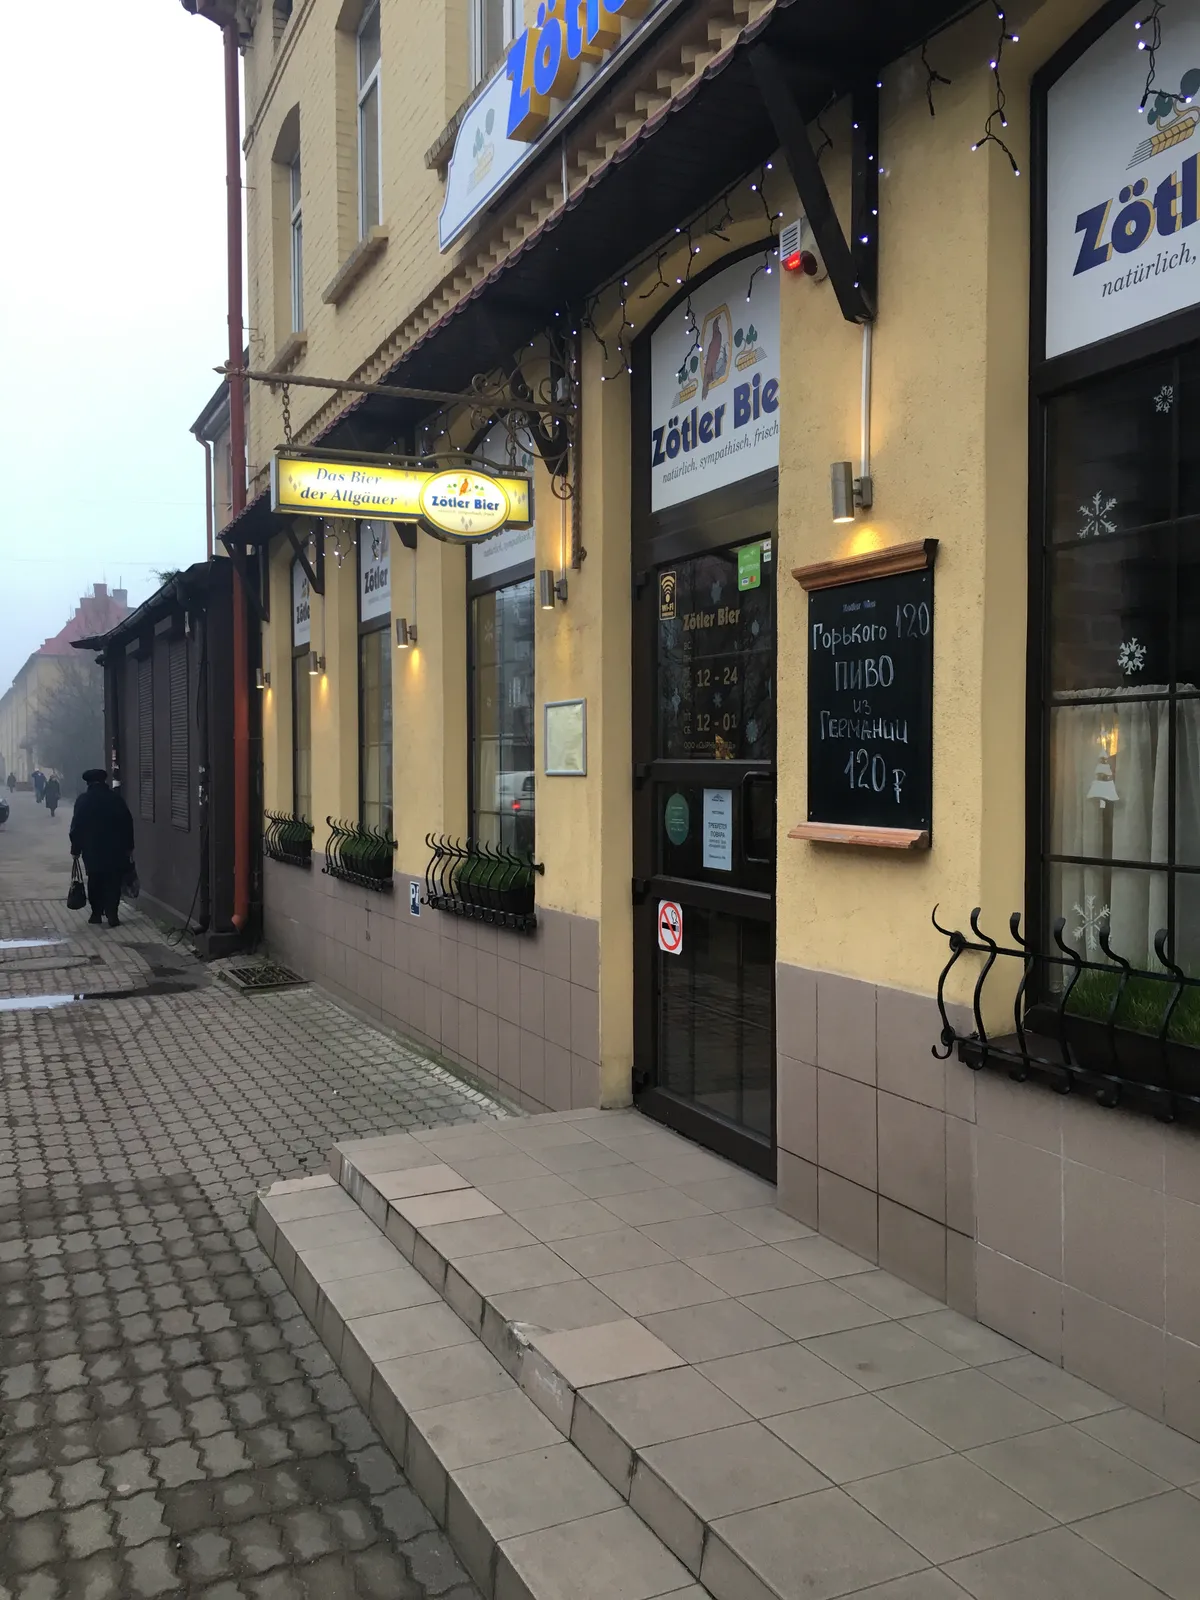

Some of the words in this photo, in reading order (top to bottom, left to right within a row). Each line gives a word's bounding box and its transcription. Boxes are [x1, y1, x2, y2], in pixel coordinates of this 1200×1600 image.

[1102, 243, 1197, 297] natürlich,
[652, 404, 727, 467] Zötler
[662, 459, 698, 484] natürlich,
[699, 434, 751, 468] sympathisch,
[316, 467, 345, 482] Das
[351, 471, 382, 485] Bier
[300, 487, 327, 500] der
[331, 489, 398, 506] Allgäuer
[431, 495, 470, 509] Zötler
[474, 499, 500, 511] Bier
[364, 566, 389, 594] Zötler
[683, 611, 715, 631] Zötler
[717, 607, 741, 626] Bier
[812, 623, 888, 655] Горького
[895, 602, 930, 638] 120
[697, 669, 711, 687] 12
[723, 666, 738, 685] 24
[834, 655, 895, 691] ПИВО
[696, 713, 711, 731] 12
[722, 713, 738, 731] 01
[844, 749, 887, 791] 120
